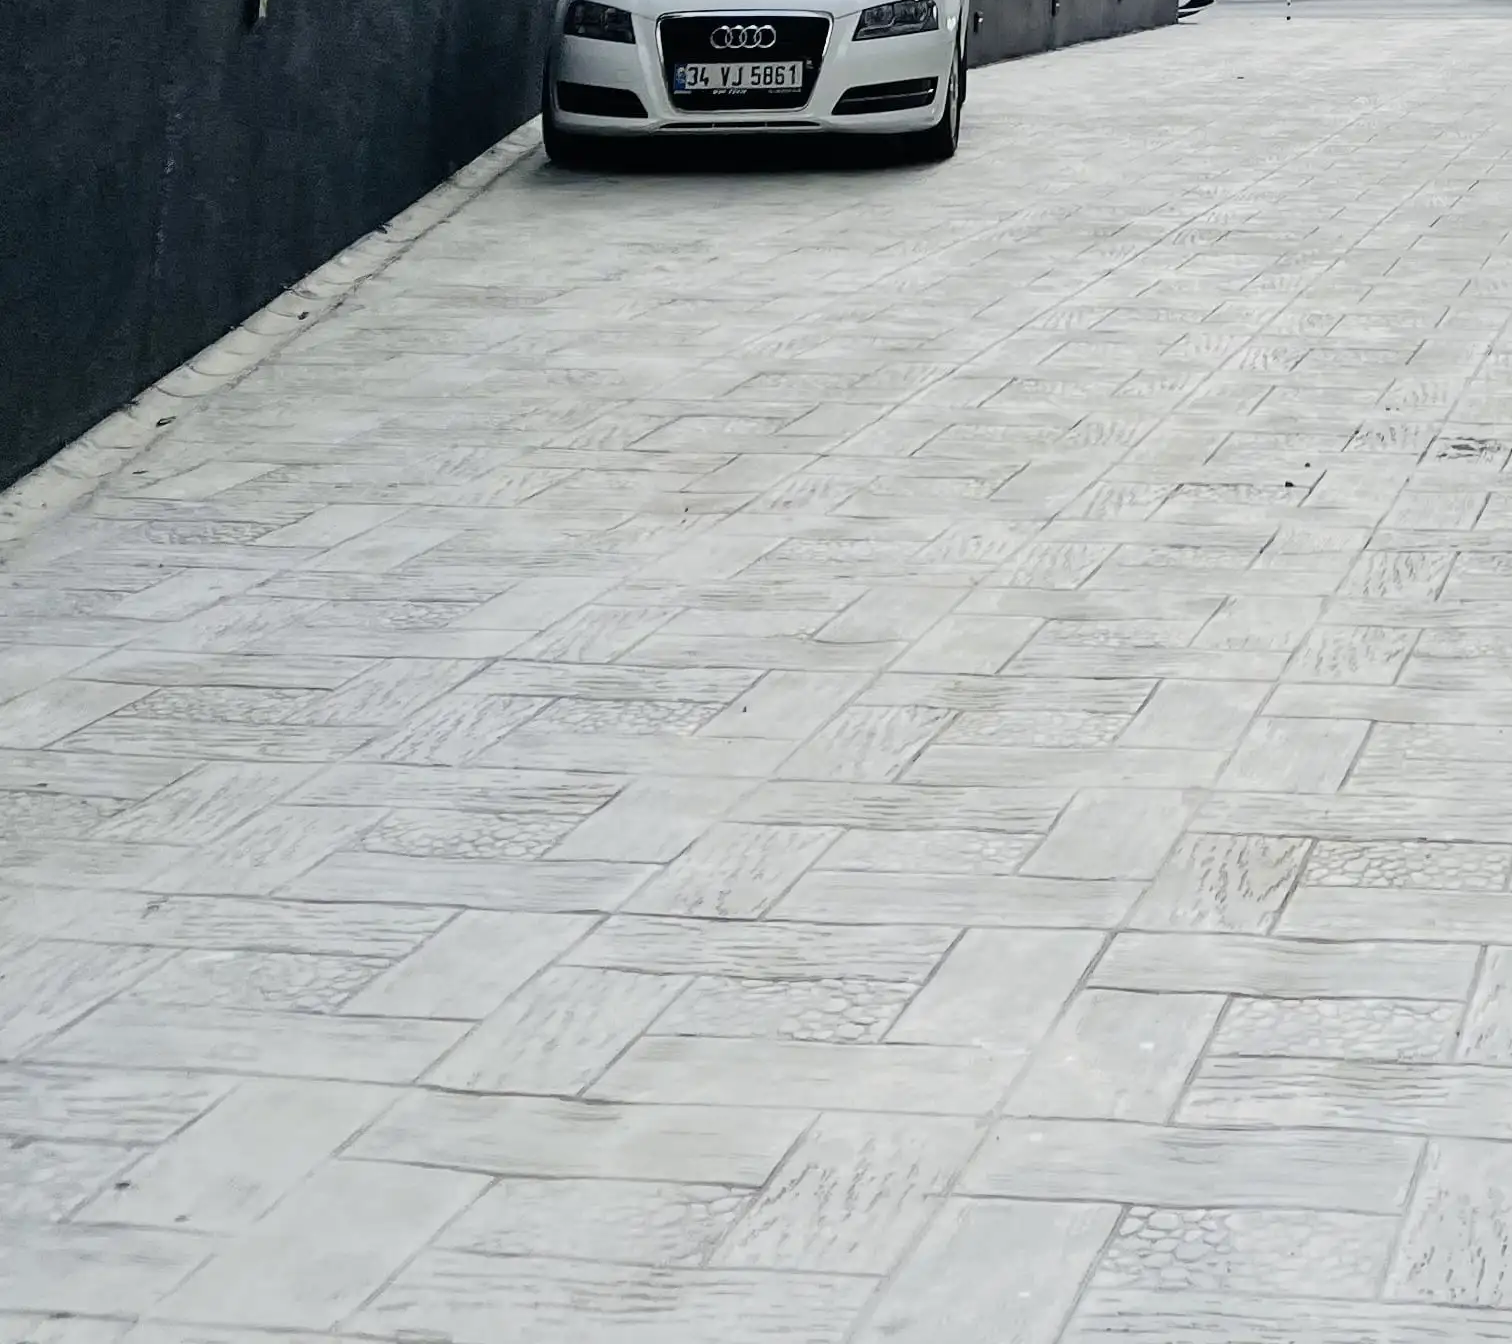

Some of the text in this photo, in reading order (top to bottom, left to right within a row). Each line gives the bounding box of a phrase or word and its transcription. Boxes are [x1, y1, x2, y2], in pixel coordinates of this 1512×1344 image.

[687, 66, 709, 87] 34
[721, 66, 743, 87] VJ
[751, 64, 797, 86] 5861
